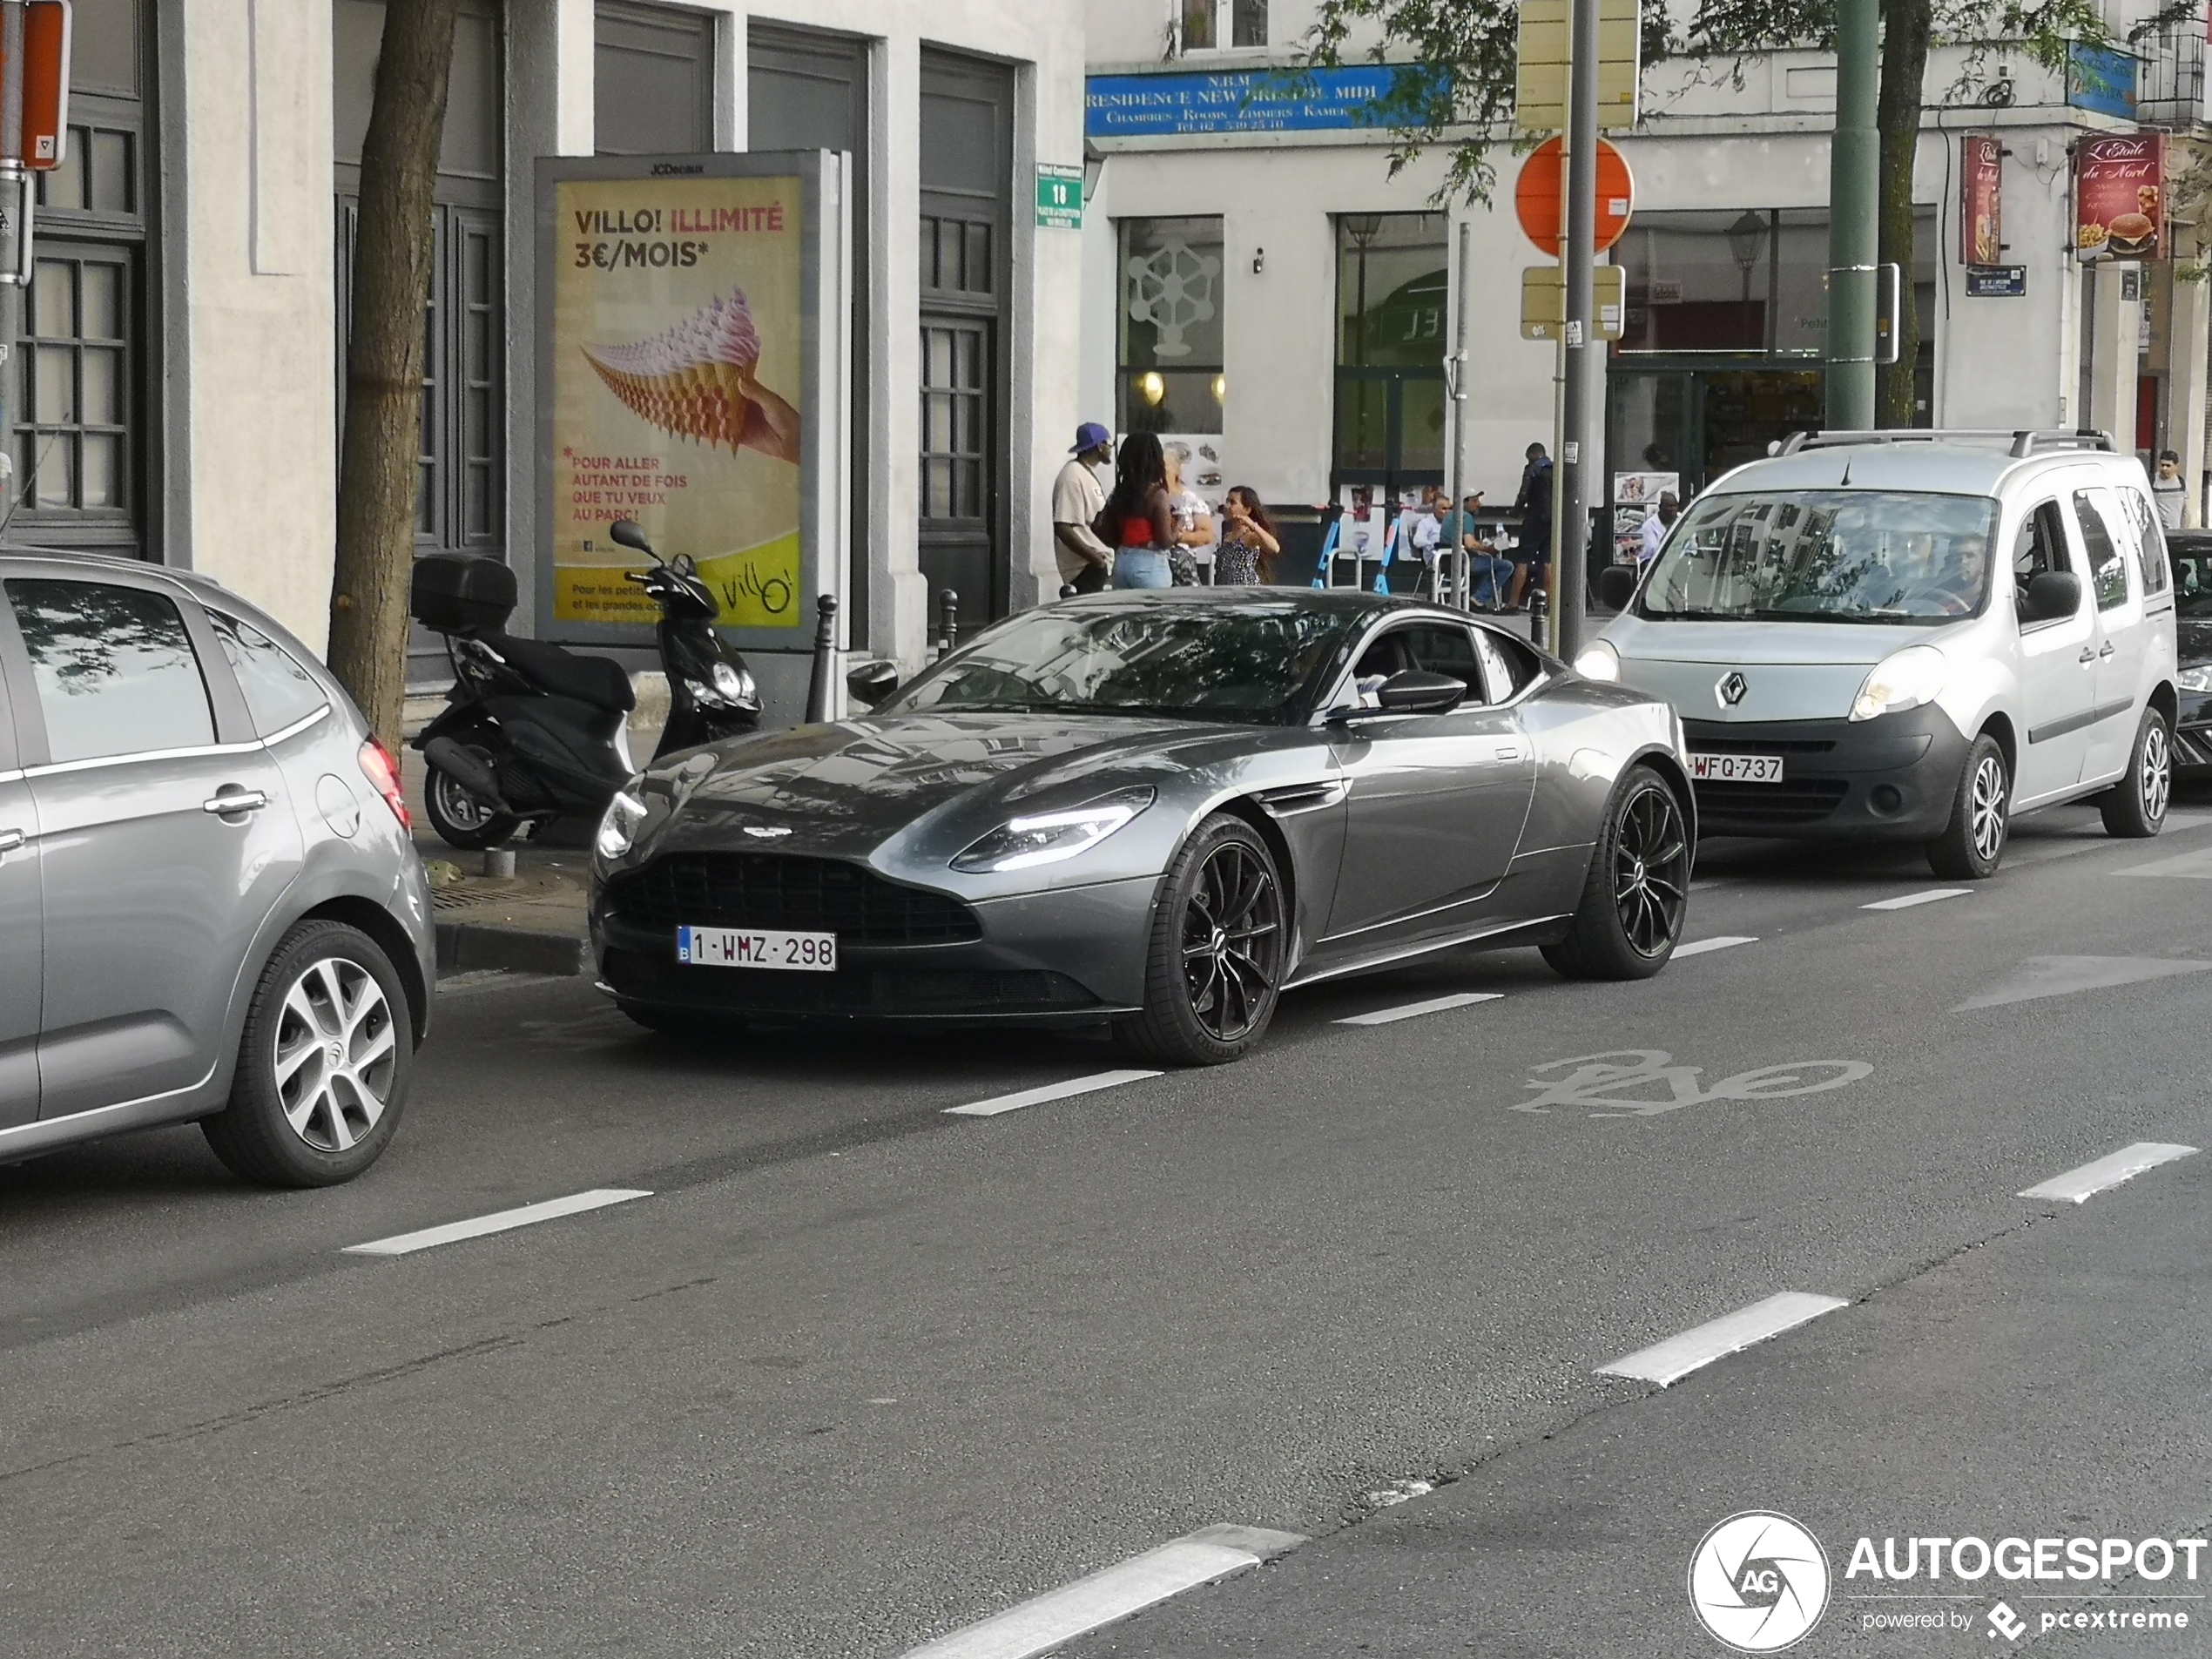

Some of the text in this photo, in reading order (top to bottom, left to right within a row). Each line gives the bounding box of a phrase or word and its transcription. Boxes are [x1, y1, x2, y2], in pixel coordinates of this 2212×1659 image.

[1085, 90, 1191, 108] RESIDENCE
[1197, 90, 1238, 104] NEW
[1335, 84, 1377, 100] MIDI
[2082, 162, 2155, 180] du Nord
[575, 199, 784, 233] VILLO! ILLIMITÉ
[614, 456, 660, 470] ALLER
[572, 474, 688, 489] AUTANT DE FOIS
[572, 490, 666, 505] QUE TU VEUX
[572, 508, 591, 522] AU
[572, 584, 596, 595] Pour
[598, 584, 613, 596] les
[572, 599, 583, 610] et
[585, 600, 600, 610] les
[603, 601, 644, 612] grandes
[679, 948, 690, 961] B
